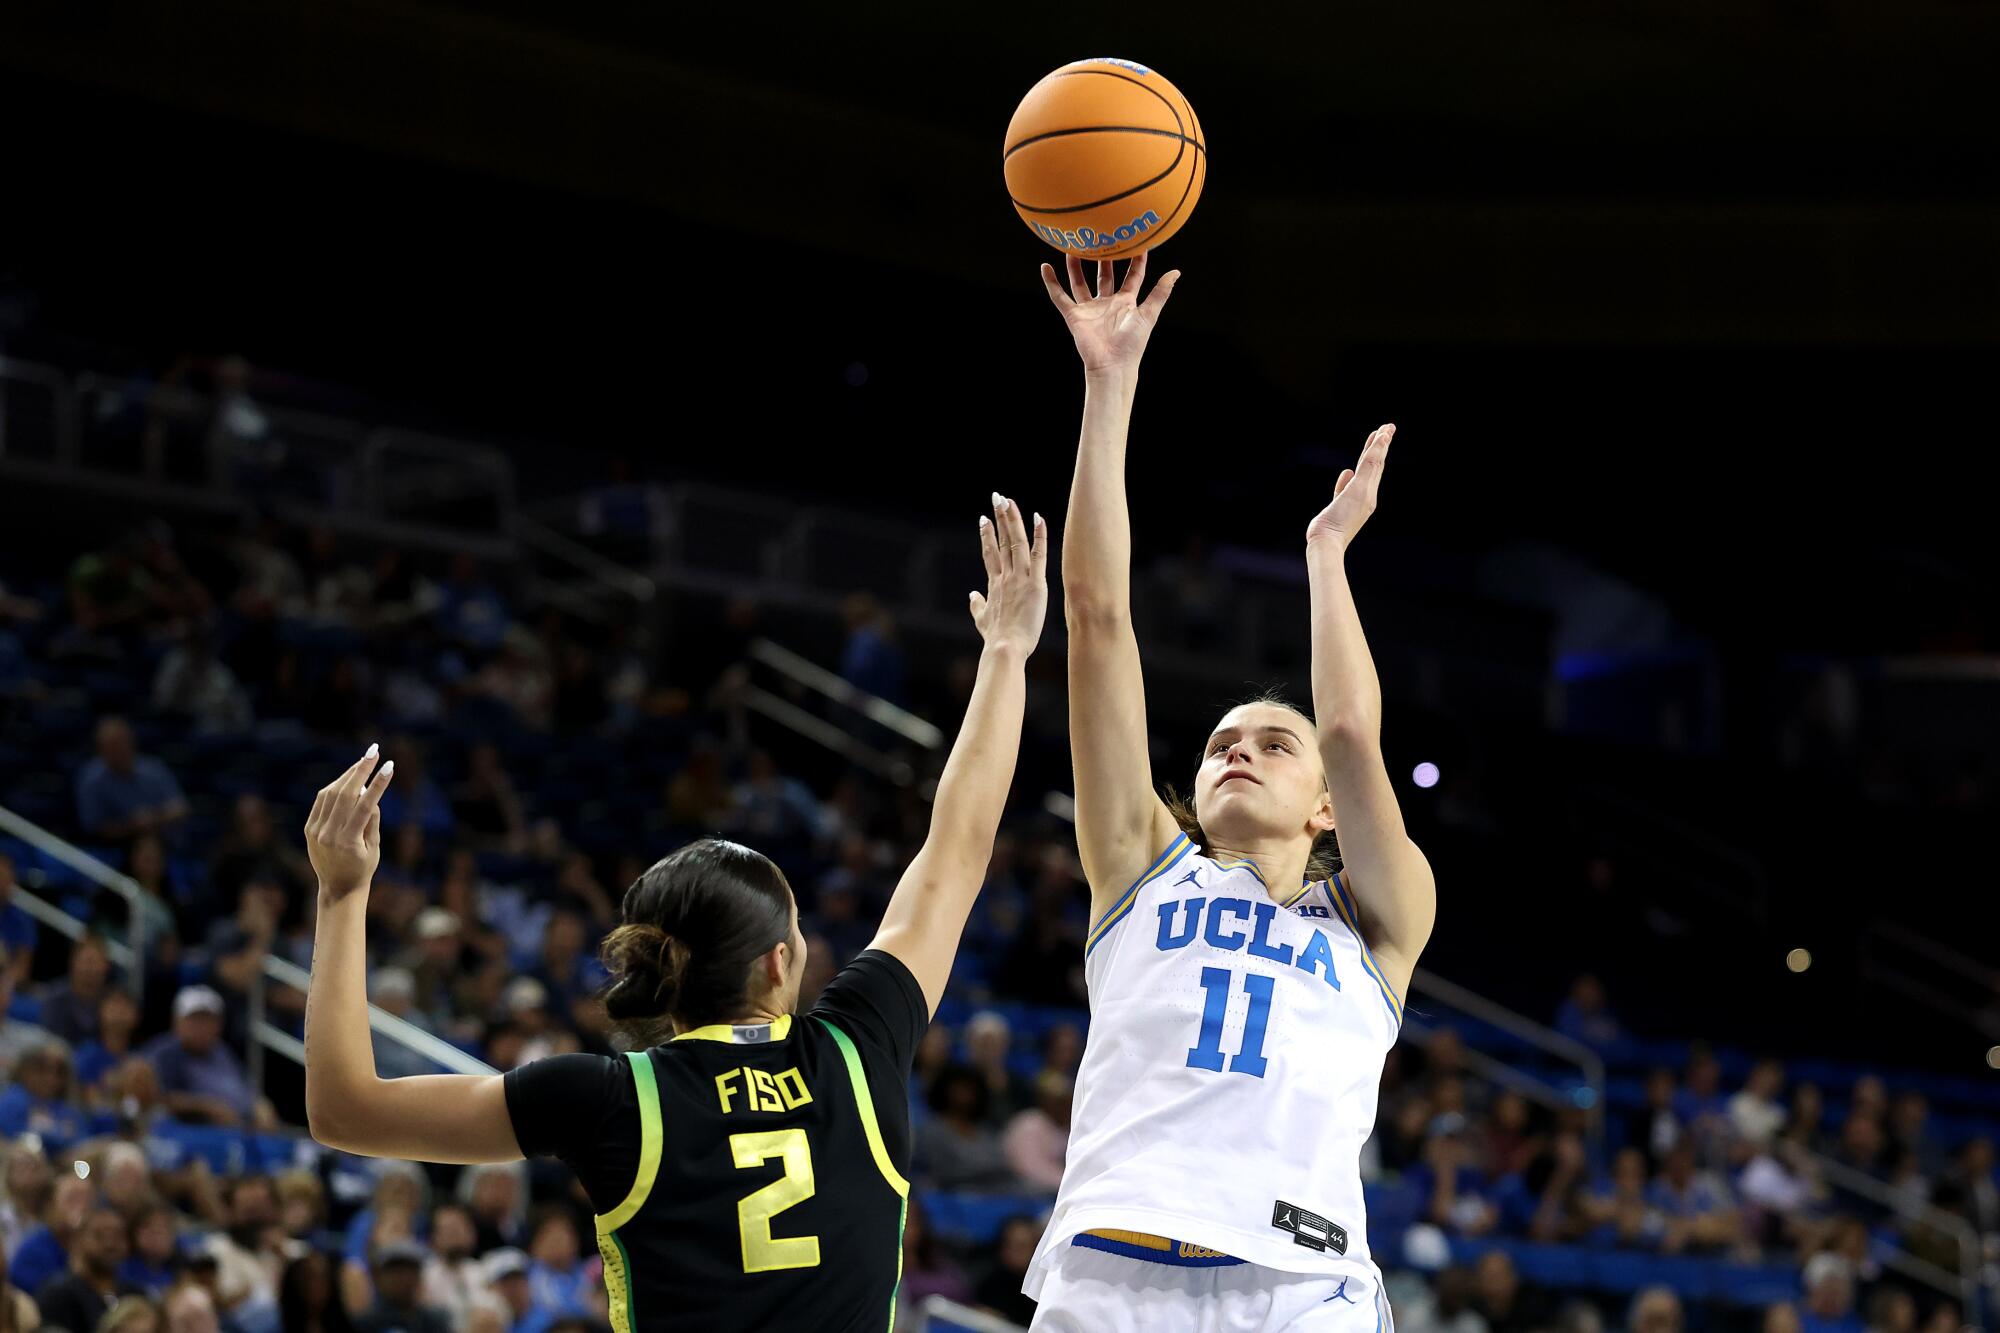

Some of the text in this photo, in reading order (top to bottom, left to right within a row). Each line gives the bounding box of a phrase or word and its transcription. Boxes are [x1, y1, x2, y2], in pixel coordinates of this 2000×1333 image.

[1030, 210, 1160, 249] Wilson
[1156, 897, 1341, 992] UCLA
[1185, 966, 1275, 1079] 11
[714, 1066, 813, 1114] FISO
[729, 1128, 821, 1273] 2
[1330, 1232, 1343, 1245] 44
